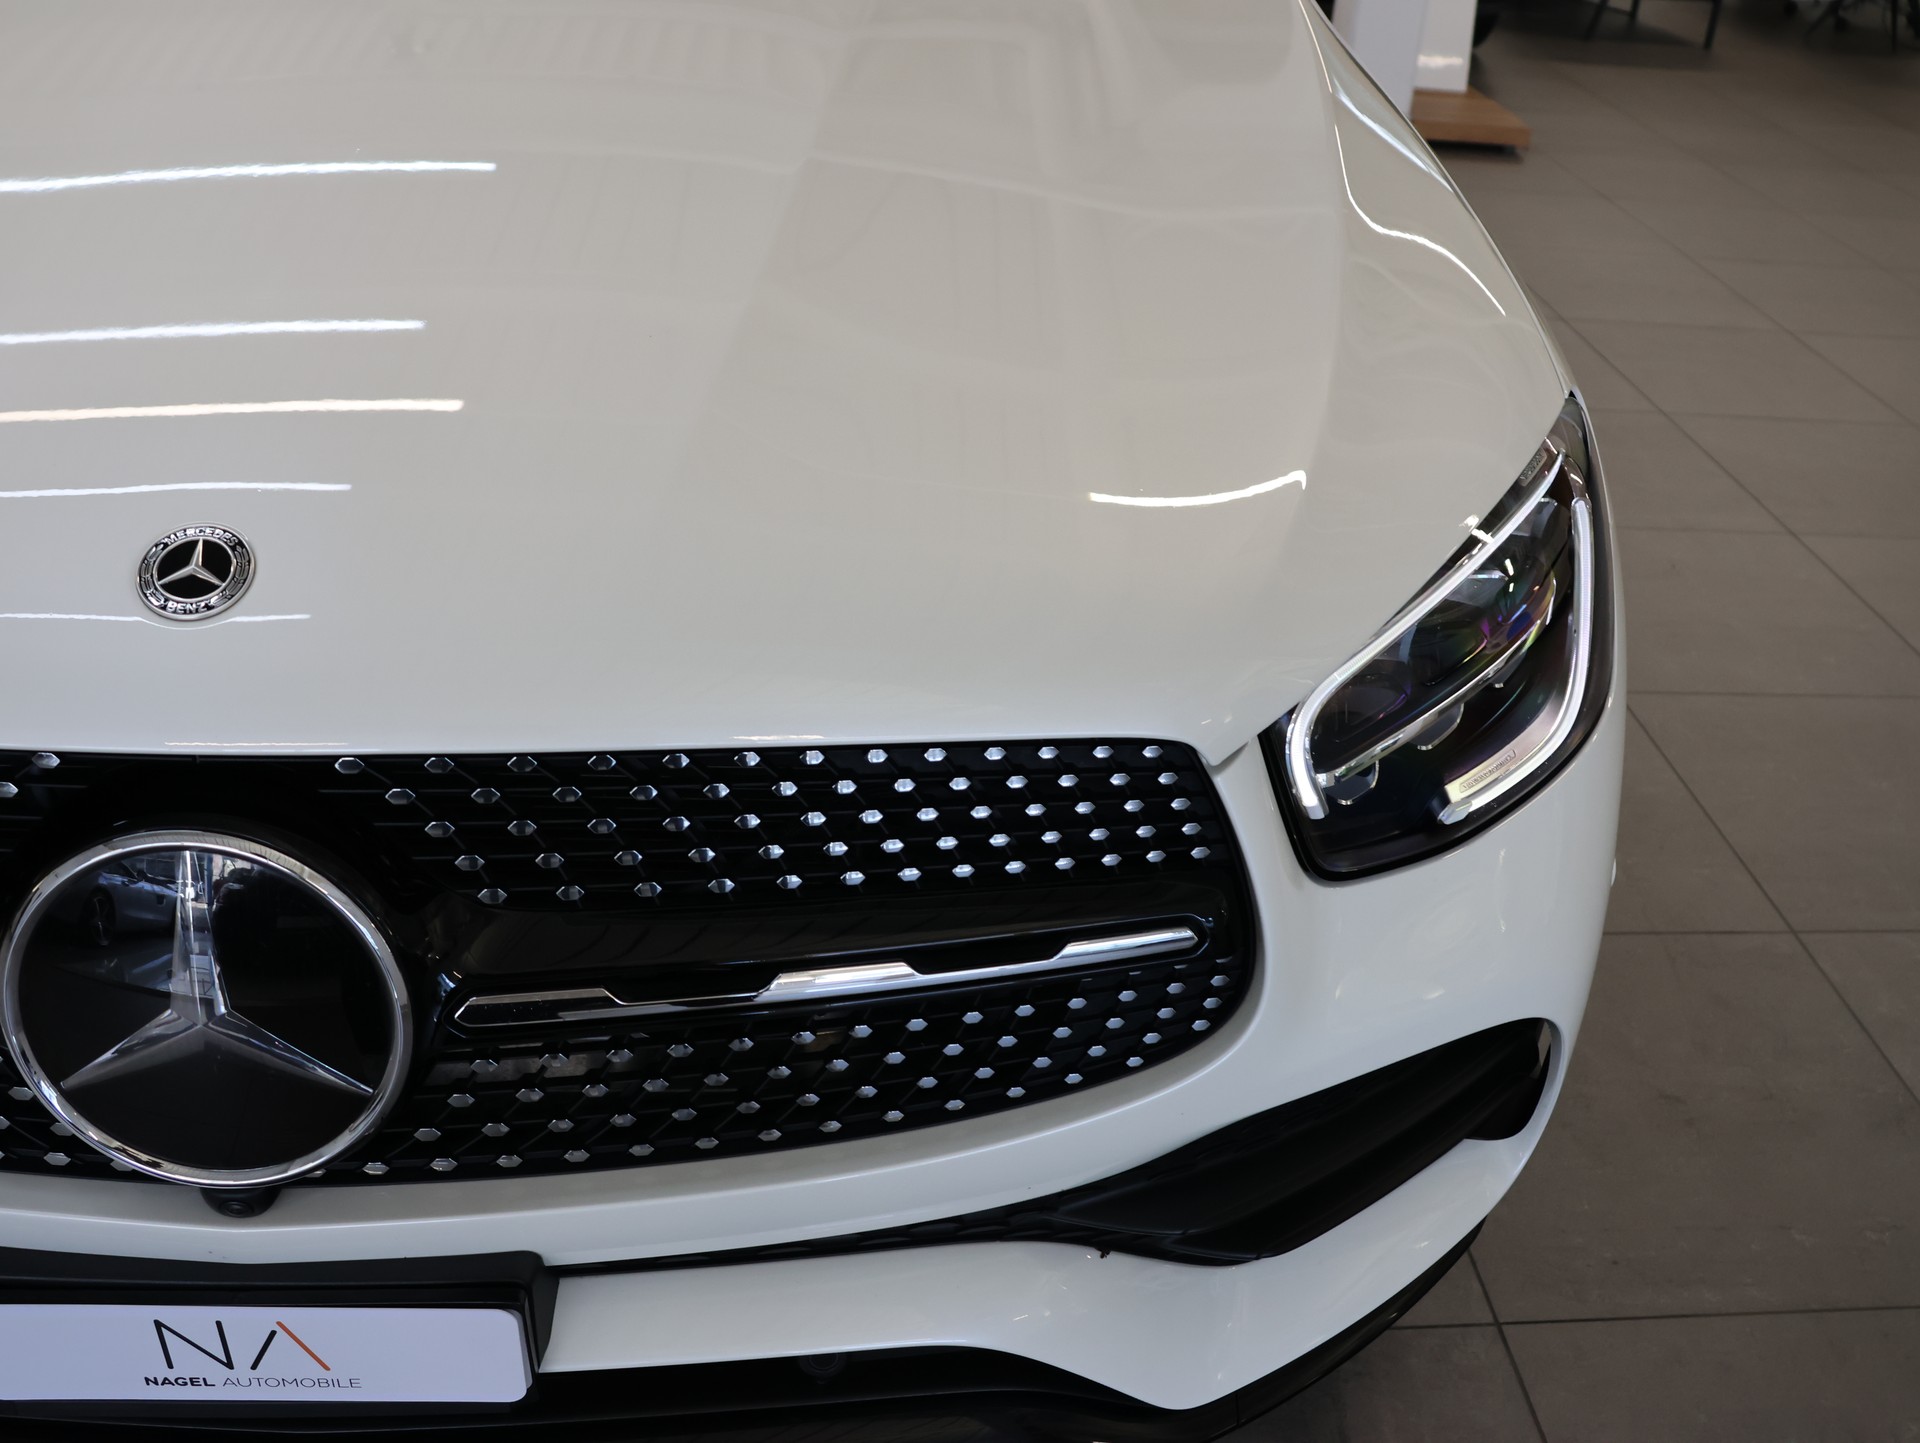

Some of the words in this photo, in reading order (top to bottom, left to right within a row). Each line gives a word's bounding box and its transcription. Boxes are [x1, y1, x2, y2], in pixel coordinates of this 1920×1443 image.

[164, 526, 238, 546] MERCEDES
[165, 600, 208, 614] BENZ
[144, 1376, 216, 1387] NAGEL
[222, 1377, 362, 1388] AUTOMOBILE
